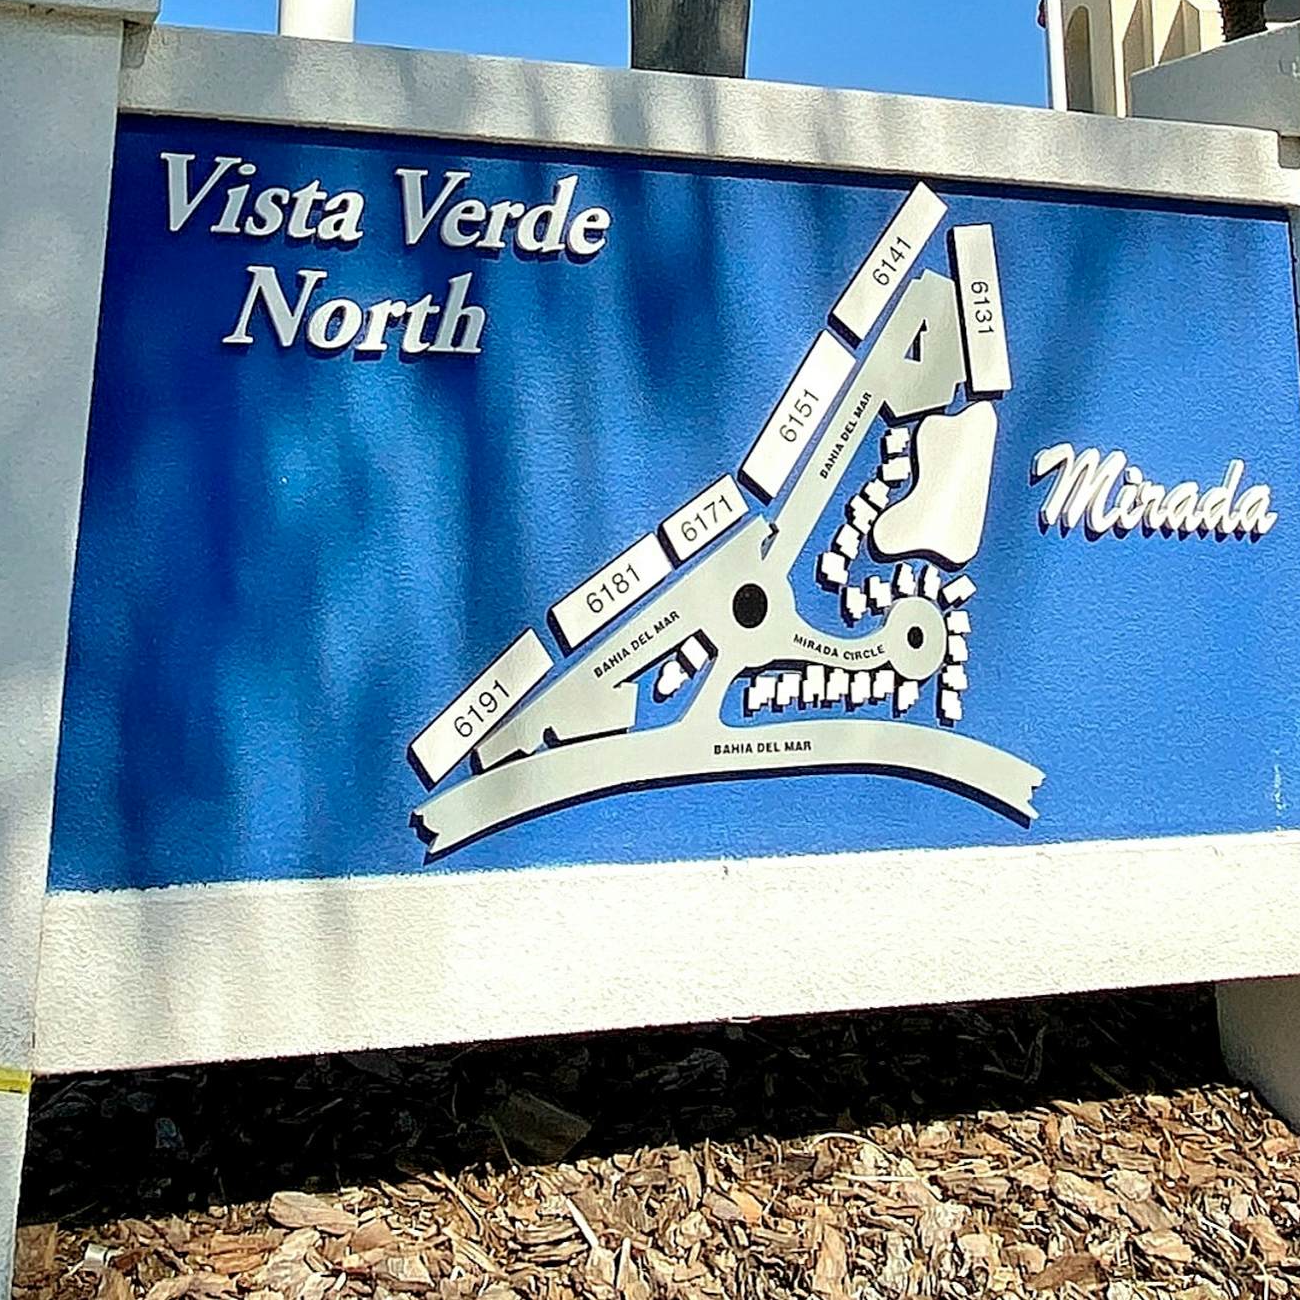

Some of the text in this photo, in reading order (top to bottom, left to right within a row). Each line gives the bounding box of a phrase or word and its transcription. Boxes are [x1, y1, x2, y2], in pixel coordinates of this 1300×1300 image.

[160, 152, 611, 256] Vista Verde
[872, 236, 912, 287] 6141
[223, 265, 488, 354] North
[971, 280, 995, 335] 6131
[779, 389, 819, 443] 6151
[820, 392, 872, 479] BAHIA DEL MAR
[1032, 443, 1278, 534] Mirada
[680, 494, 734, 542] 6171
[586, 564, 641, 614] 6181
[593, 611, 680, 678] BAHIA DEL MAR
[793, 633, 886, 661] MIRADA CIRCLE
[454, 679, 509, 738] 6191
[713, 740, 812, 755] BAHIA DEL MAR
